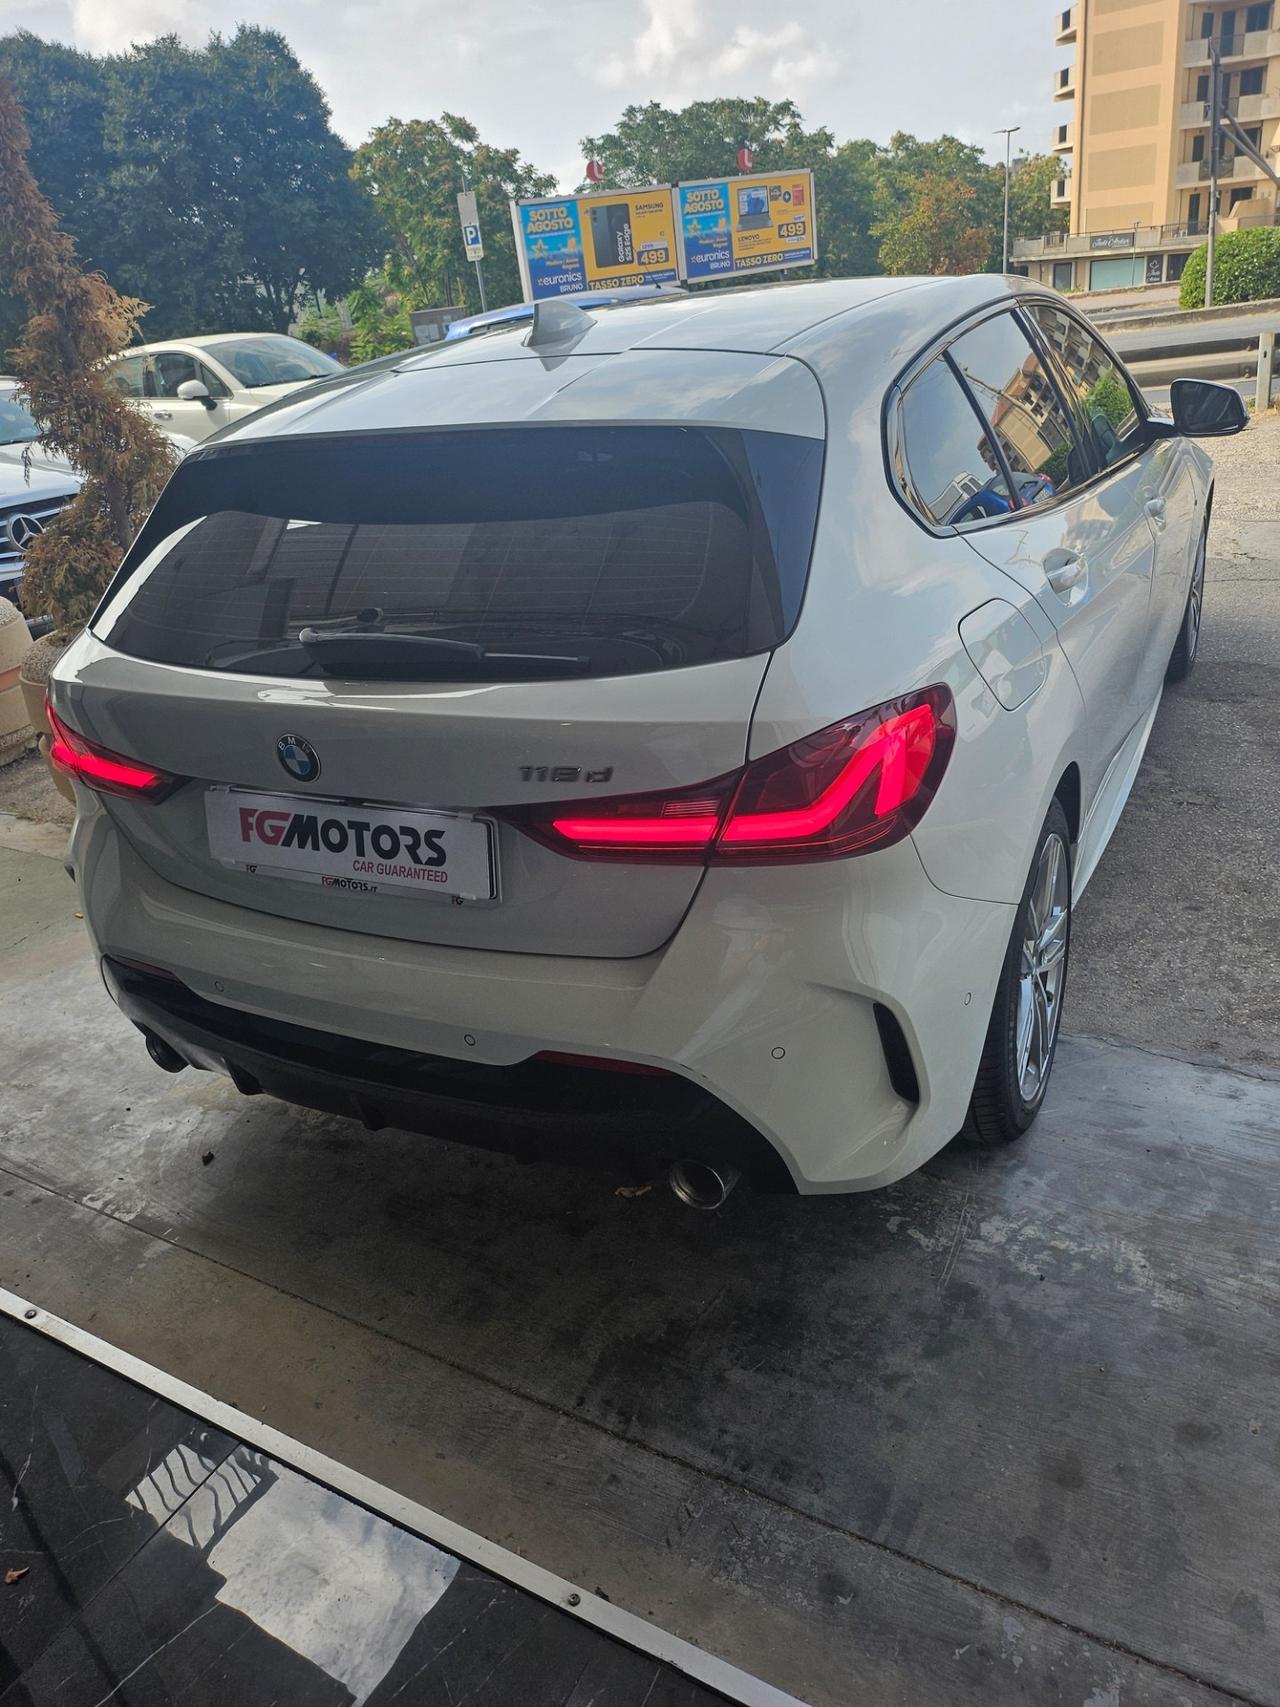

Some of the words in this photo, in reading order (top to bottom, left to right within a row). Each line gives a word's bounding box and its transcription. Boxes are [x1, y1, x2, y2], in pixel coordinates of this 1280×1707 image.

[686, 189, 719, 202] SOTTO
[684, 199, 724, 214] AGOSTO
[529, 207, 567, 222] SOTTO
[528, 217, 573, 233] AGOSTO
[780, 223, 804, 237] 499
[466, 228, 476, 244] P
[616, 231, 625, 263] Galaxy
[640, 249, 666, 264] 499
[696, 249, 730, 263] euronics
[735, 257, 762, 268] TASSO
[762, 253, 784, 264] ZERO
[543, 272, 582, 286] euronics
[589, 279, 620, 291] TASSO
[620, 275, 645, 287] ZERO
[559, 283, 584, 293] BRUNO
[352, 859, 375, 875] CAR
[376, 863, 448, 884] GUARANTEED
